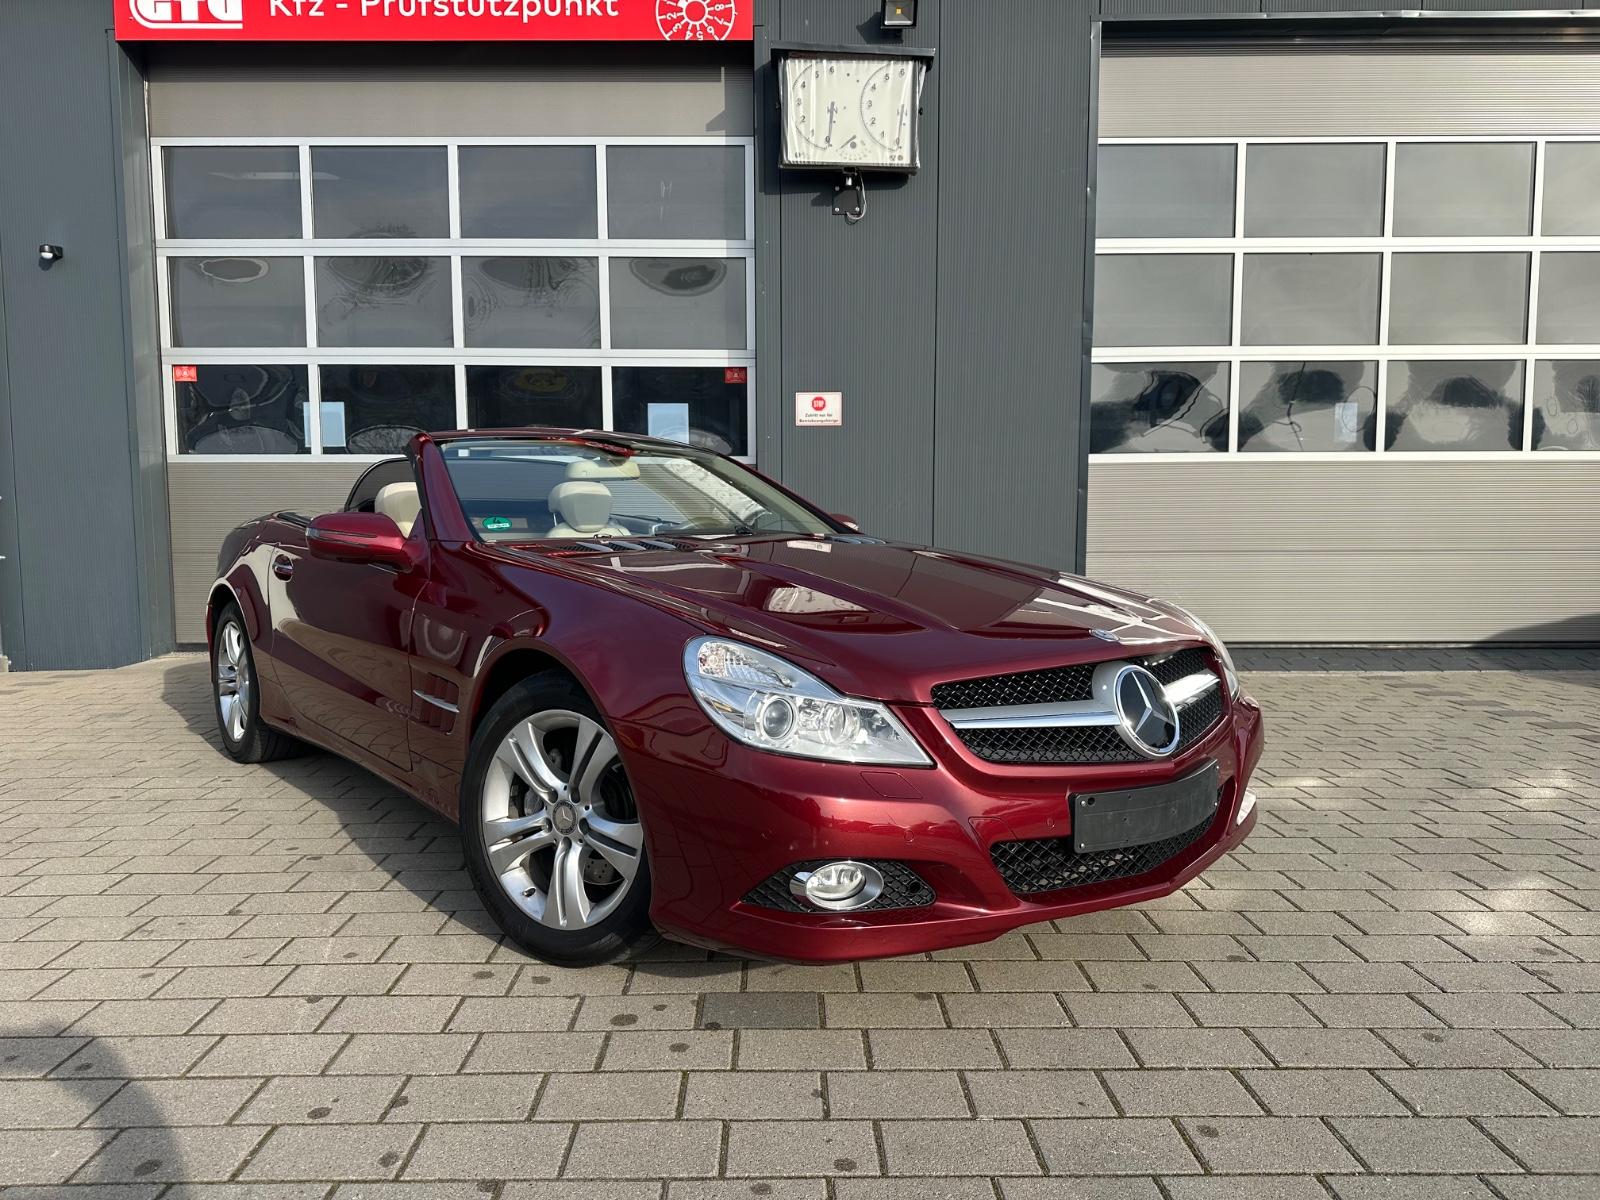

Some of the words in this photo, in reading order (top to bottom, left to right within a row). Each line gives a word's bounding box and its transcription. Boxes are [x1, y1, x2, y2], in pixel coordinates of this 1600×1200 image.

[270, 0, 325, 17] Kfz
[714, 3, 725, 11] 8
[829, 66, 835, 74] 6
[884, 73, 890, 81] 5
[867, 100, 873, 108] 3
[800, 115, 806, 123] 2
[870, 117, 876, 125] 2
